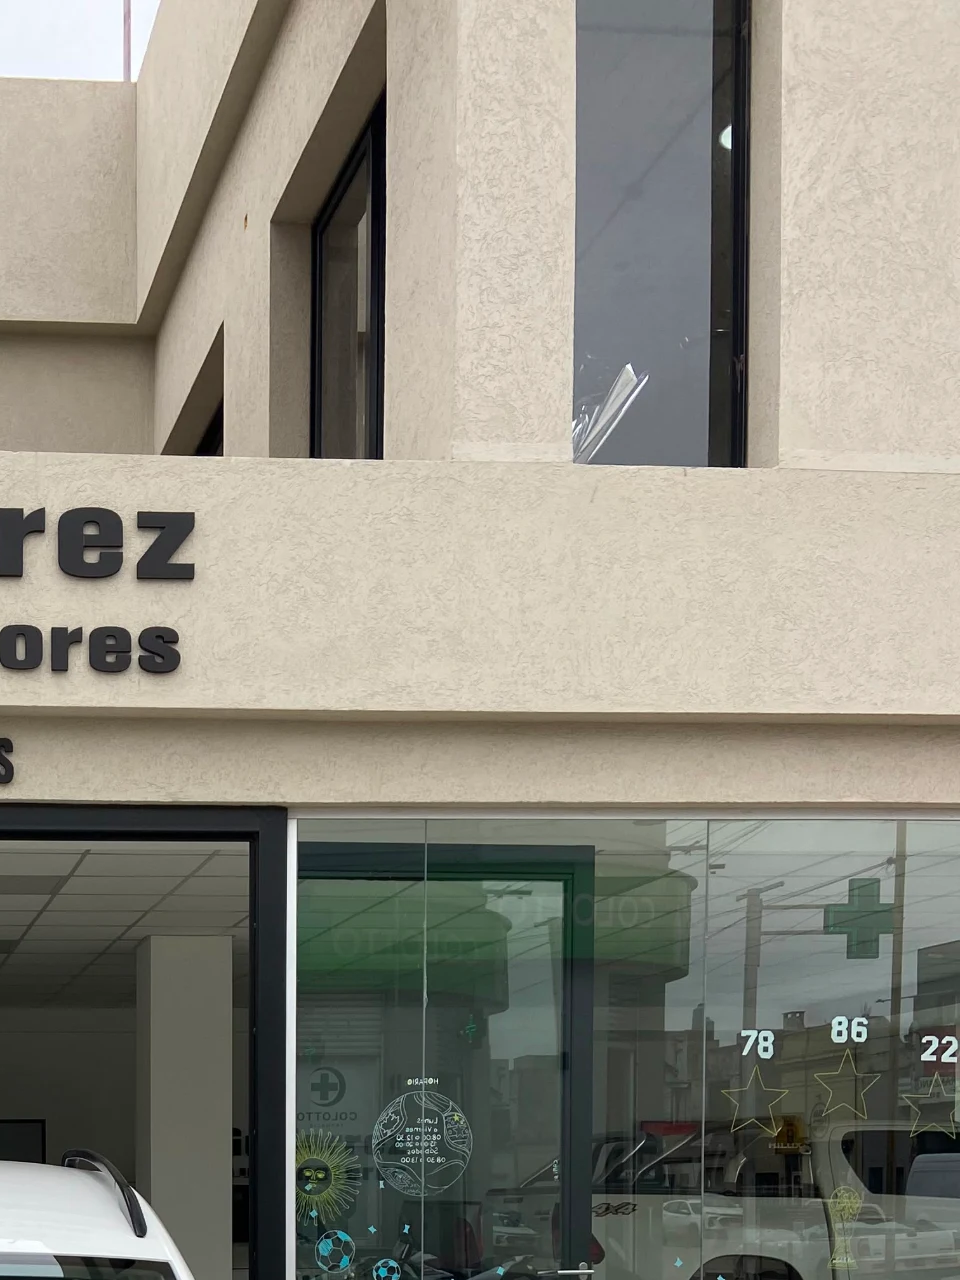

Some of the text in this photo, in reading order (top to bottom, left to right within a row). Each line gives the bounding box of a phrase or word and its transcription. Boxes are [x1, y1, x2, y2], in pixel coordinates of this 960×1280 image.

[831, 1015, 868, 1043] 86
[740, 1029, 775, 1060] 78
[920, 1035, 958, 1063] 22
